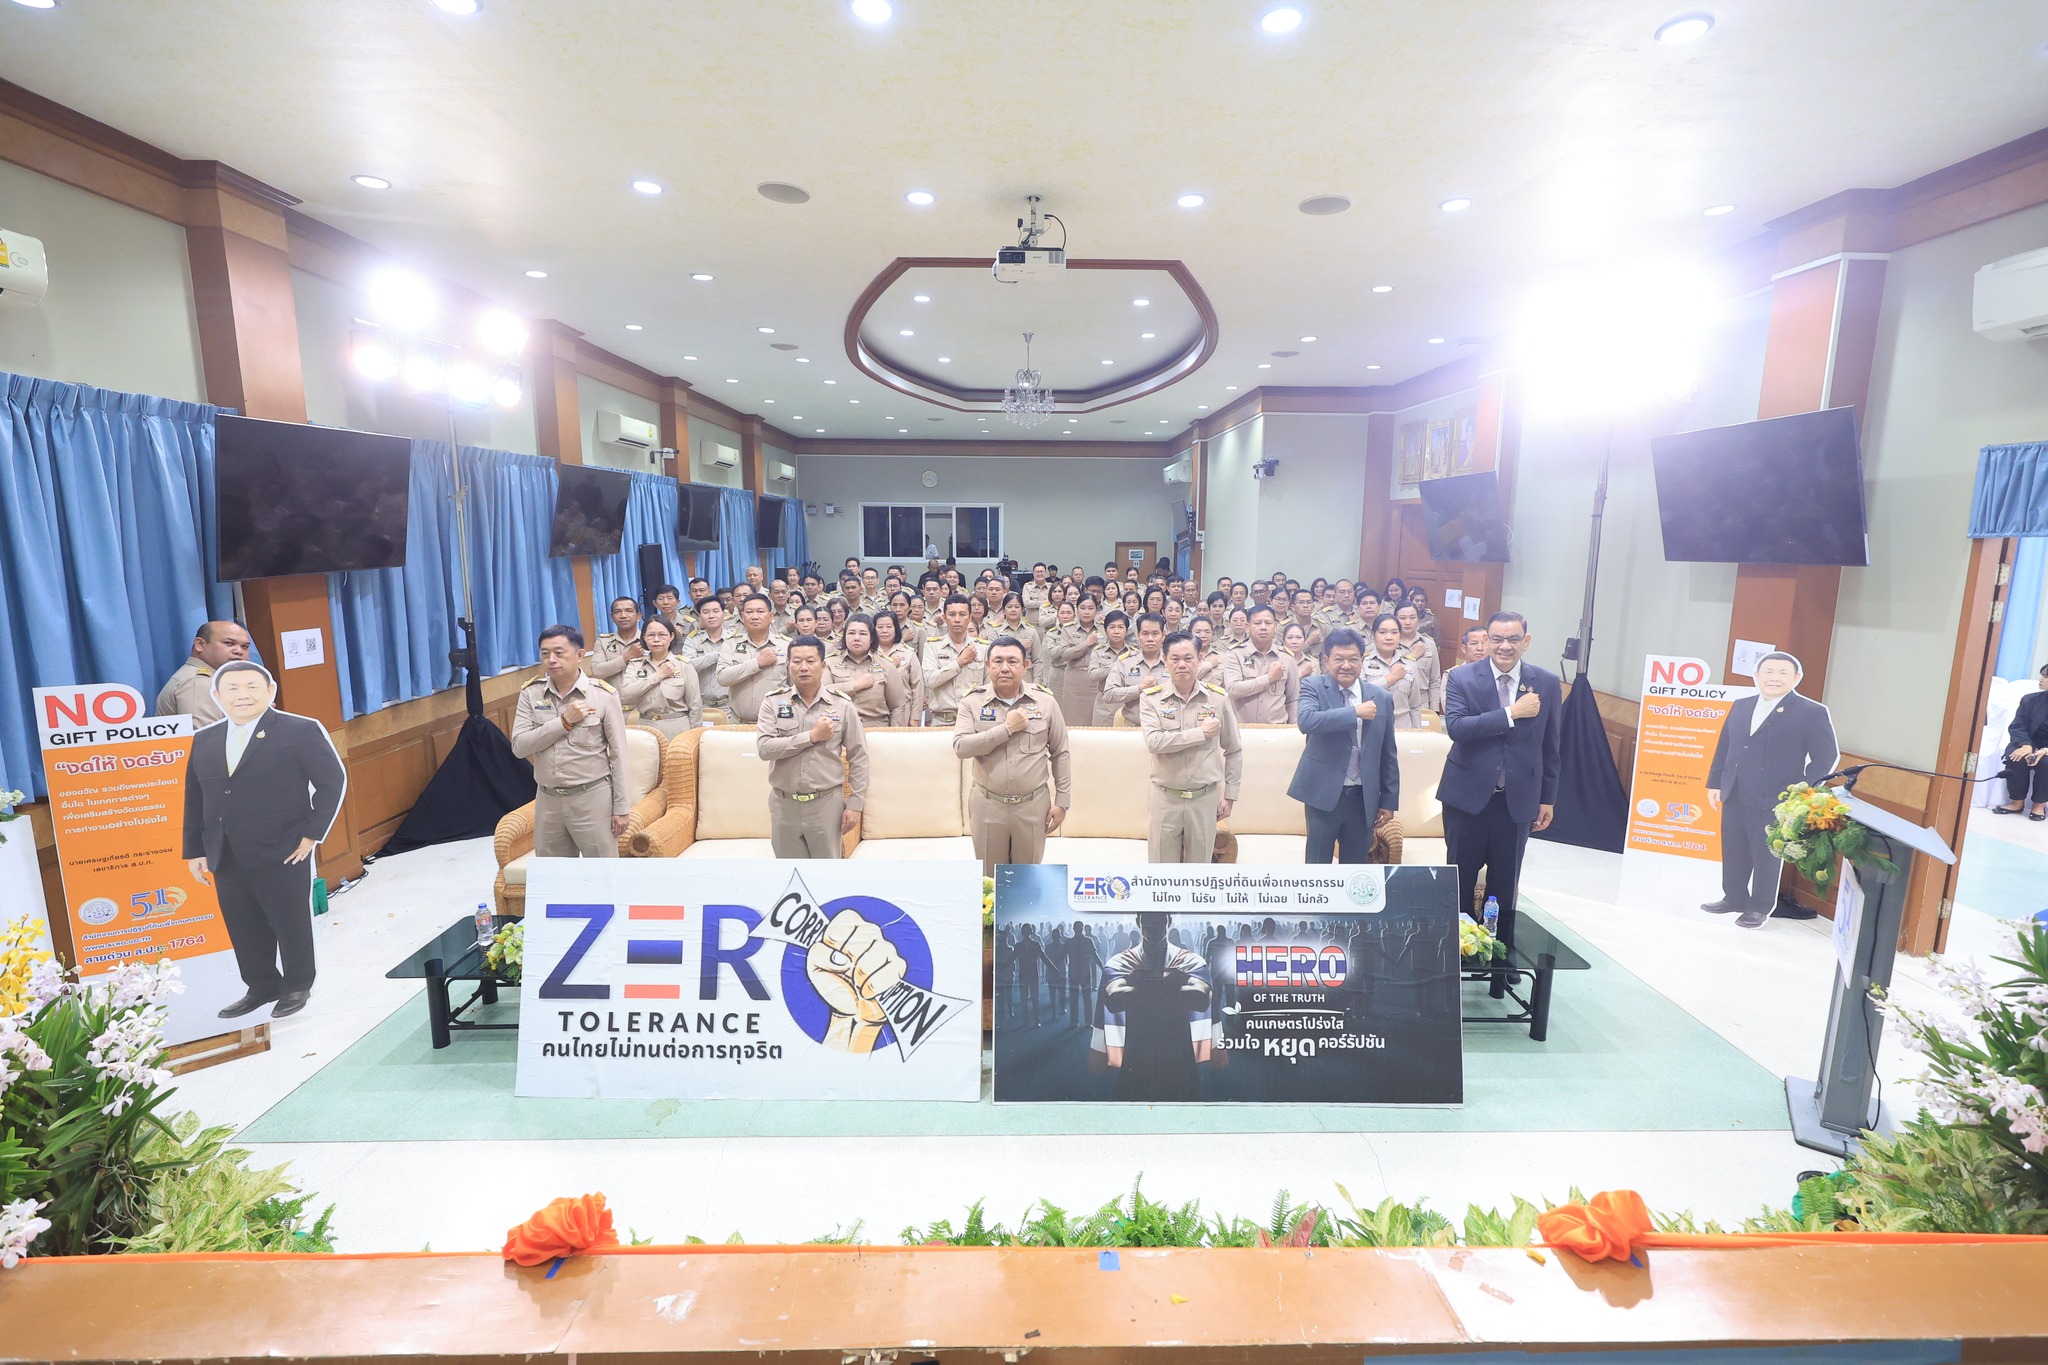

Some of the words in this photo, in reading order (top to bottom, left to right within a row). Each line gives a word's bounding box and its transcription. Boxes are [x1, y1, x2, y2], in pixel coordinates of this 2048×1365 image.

[1651, 660, 1704, 686] NO
[1649, 686, 1676, 695] GIFT
[1680, 688, 1726, 698] POLICY
[44, 690, 137, 729] NO
[50, 731, 97, 745] GIFT
[106, 723, 179, 741] POLICY
[1666, 803, 1690, 820] 51
[1683, 841, 1706, 851] 1764
[1131, 873, 1344, 890] สำนักงานการปฏิรูปที่ดินเพื่อเกษตรกรรม
[131, 888, 169, 917] 51
[1152, 892, 1181, 903] ไม่โกง
[1191, 892, 1216, 904] ไม่รับ
[1226, 892, 1249, 904] ไม่ให้
[1258, 892, 1287, 904] ไม่เฉย
[1297, 893, 1329, 904] ไม่กลัว
[85, 950, 131, 964] สายด่วน
[168, 935, 206, 950] 1764
[1236, 945, 1347, 987] HERO
[1253, 993, 1267, 1003] OF
[1269, 993, 1289, 1003] THE
[1291, 993, 1325, 1003] TRUTH
[558, 1011, 760, 1034] TOLERANCE
[1246, 1016, 1344, 1030] คนเกษตรโปร่งใส
[542, 1037, 782, 1065] คนไทยไม่ทนต่อการทุจริต
[1217, 1033, 1260, 1050] ร่วมใจ
[1264, 1037, 1316, 1065] หยุด
[1318, 1033, 1385, 1049] คอร์รัปชัน
